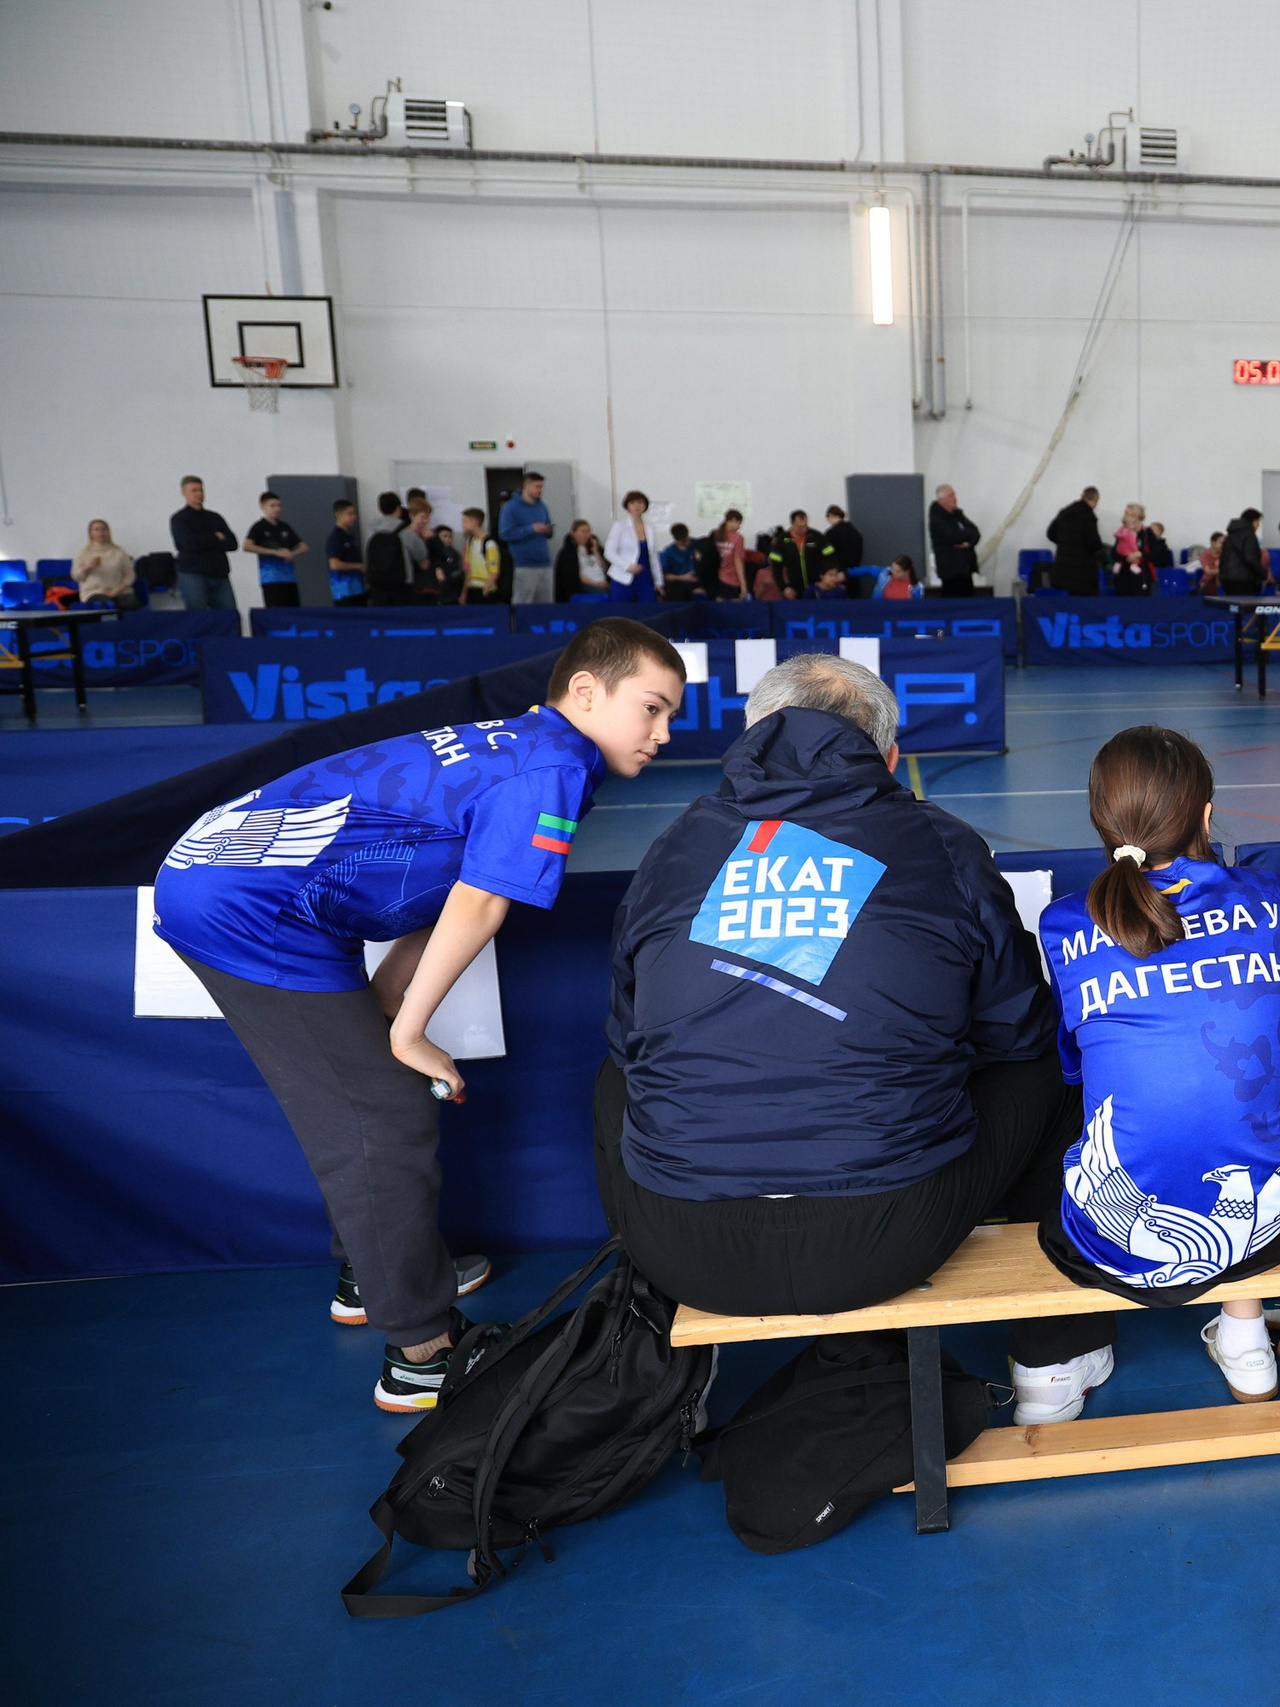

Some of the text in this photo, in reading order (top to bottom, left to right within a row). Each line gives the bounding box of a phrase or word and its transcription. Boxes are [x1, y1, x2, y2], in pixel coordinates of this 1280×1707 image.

[722, 855, 854, 896] EKAT
[717, 897, 850, 942] 2023
[815, 1505, 831, 1524] SPORT
